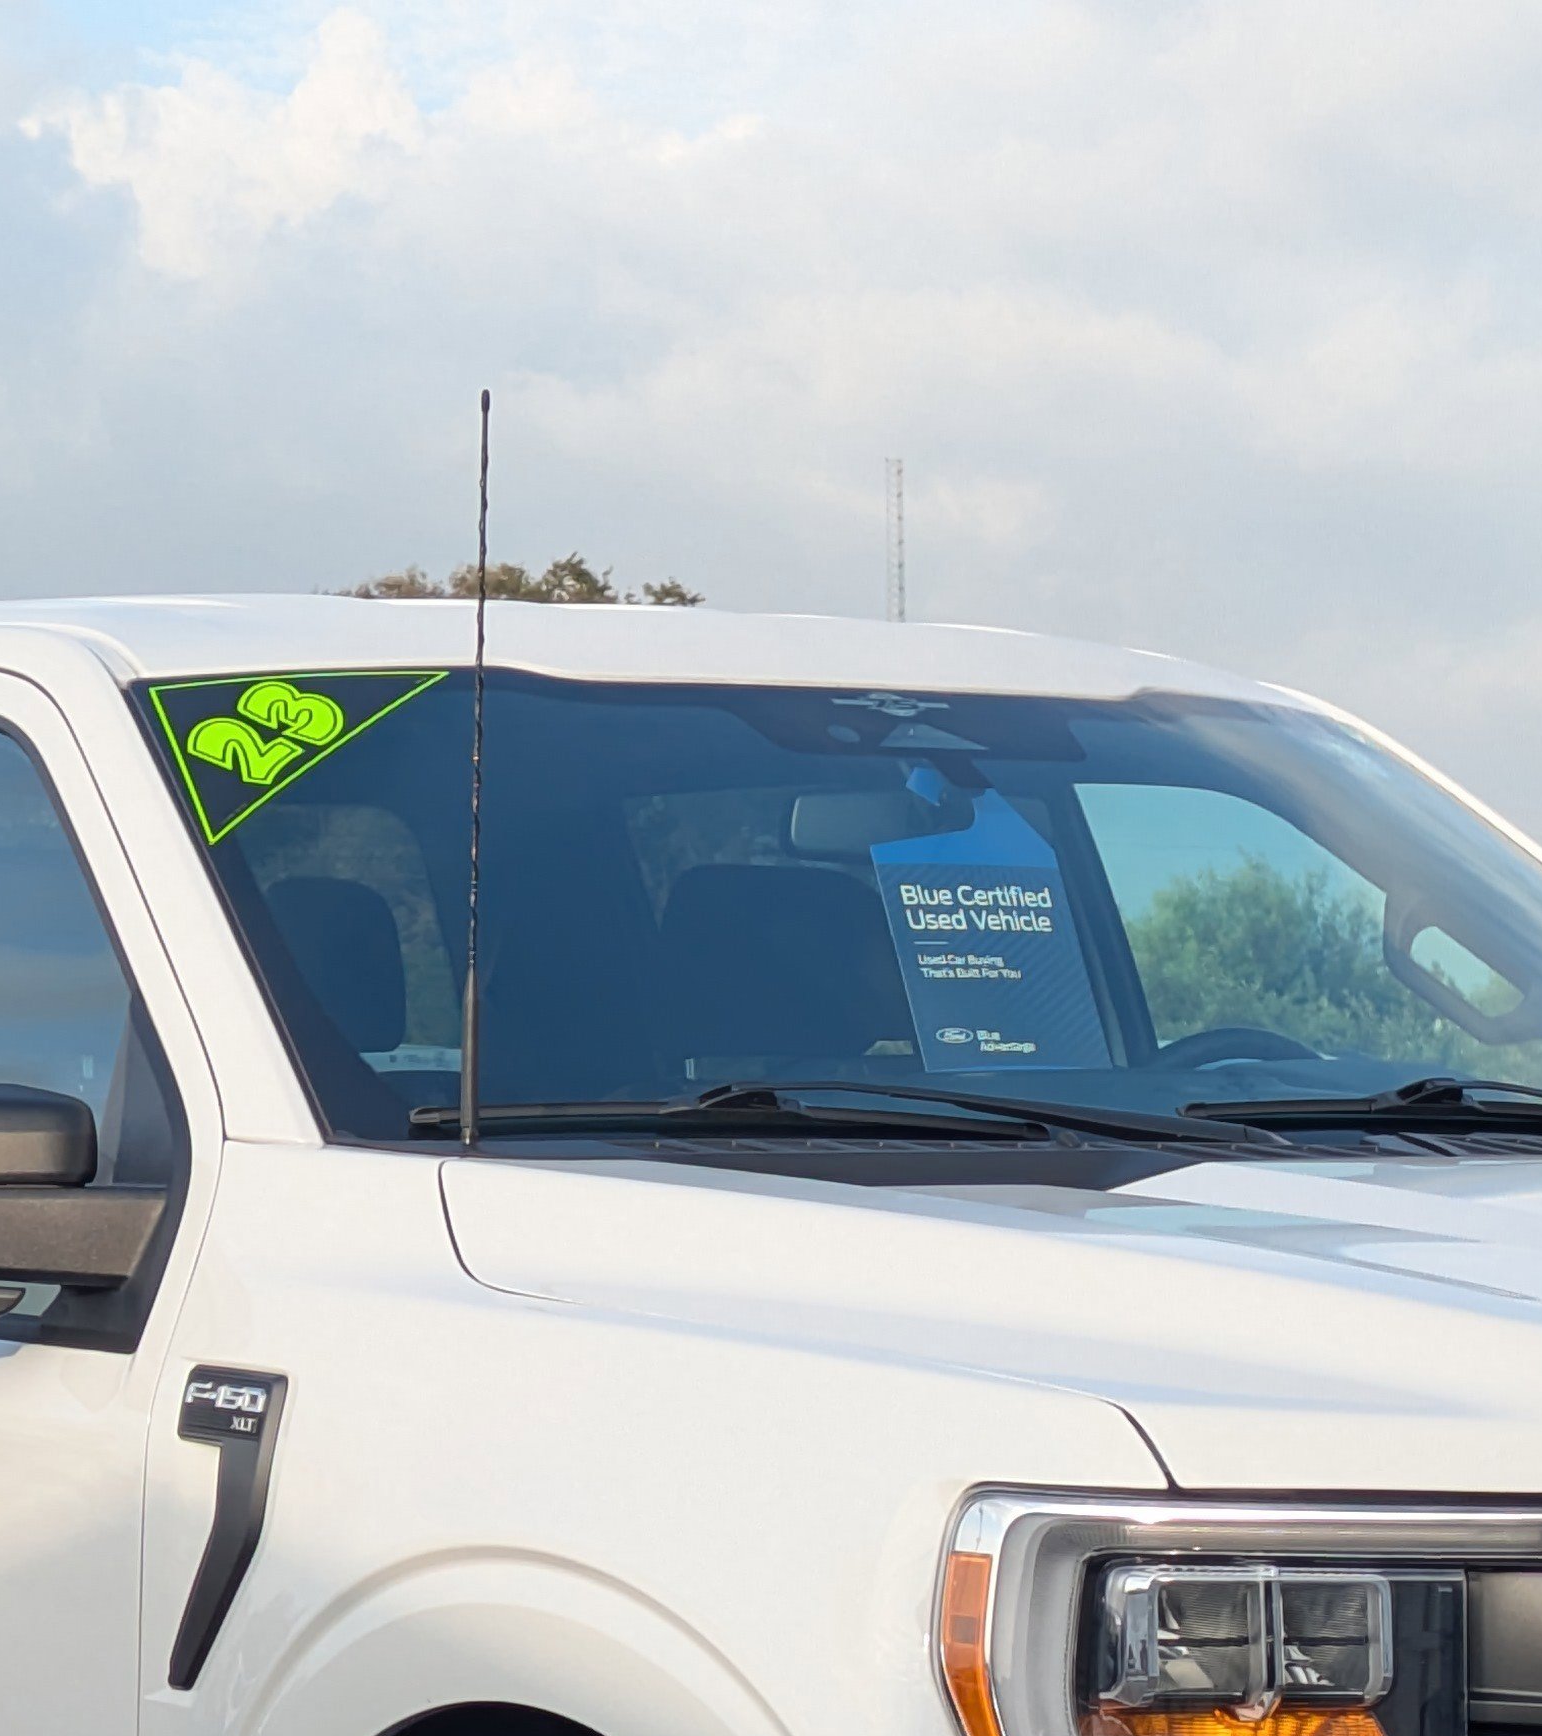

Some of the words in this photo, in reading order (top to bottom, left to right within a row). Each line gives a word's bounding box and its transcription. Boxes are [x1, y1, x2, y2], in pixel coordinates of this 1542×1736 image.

[187, 681, 344, 785] 23
[900, 885, 953, 906] Blue
[957, 885, 1053, 908] Certified
[906, 909, 967, 931] Used
[970, 909, 1053, 932] Vehicle
[185, 1381, 268, 1413] F-150
[230, 1416, 257, 1433] XLT
